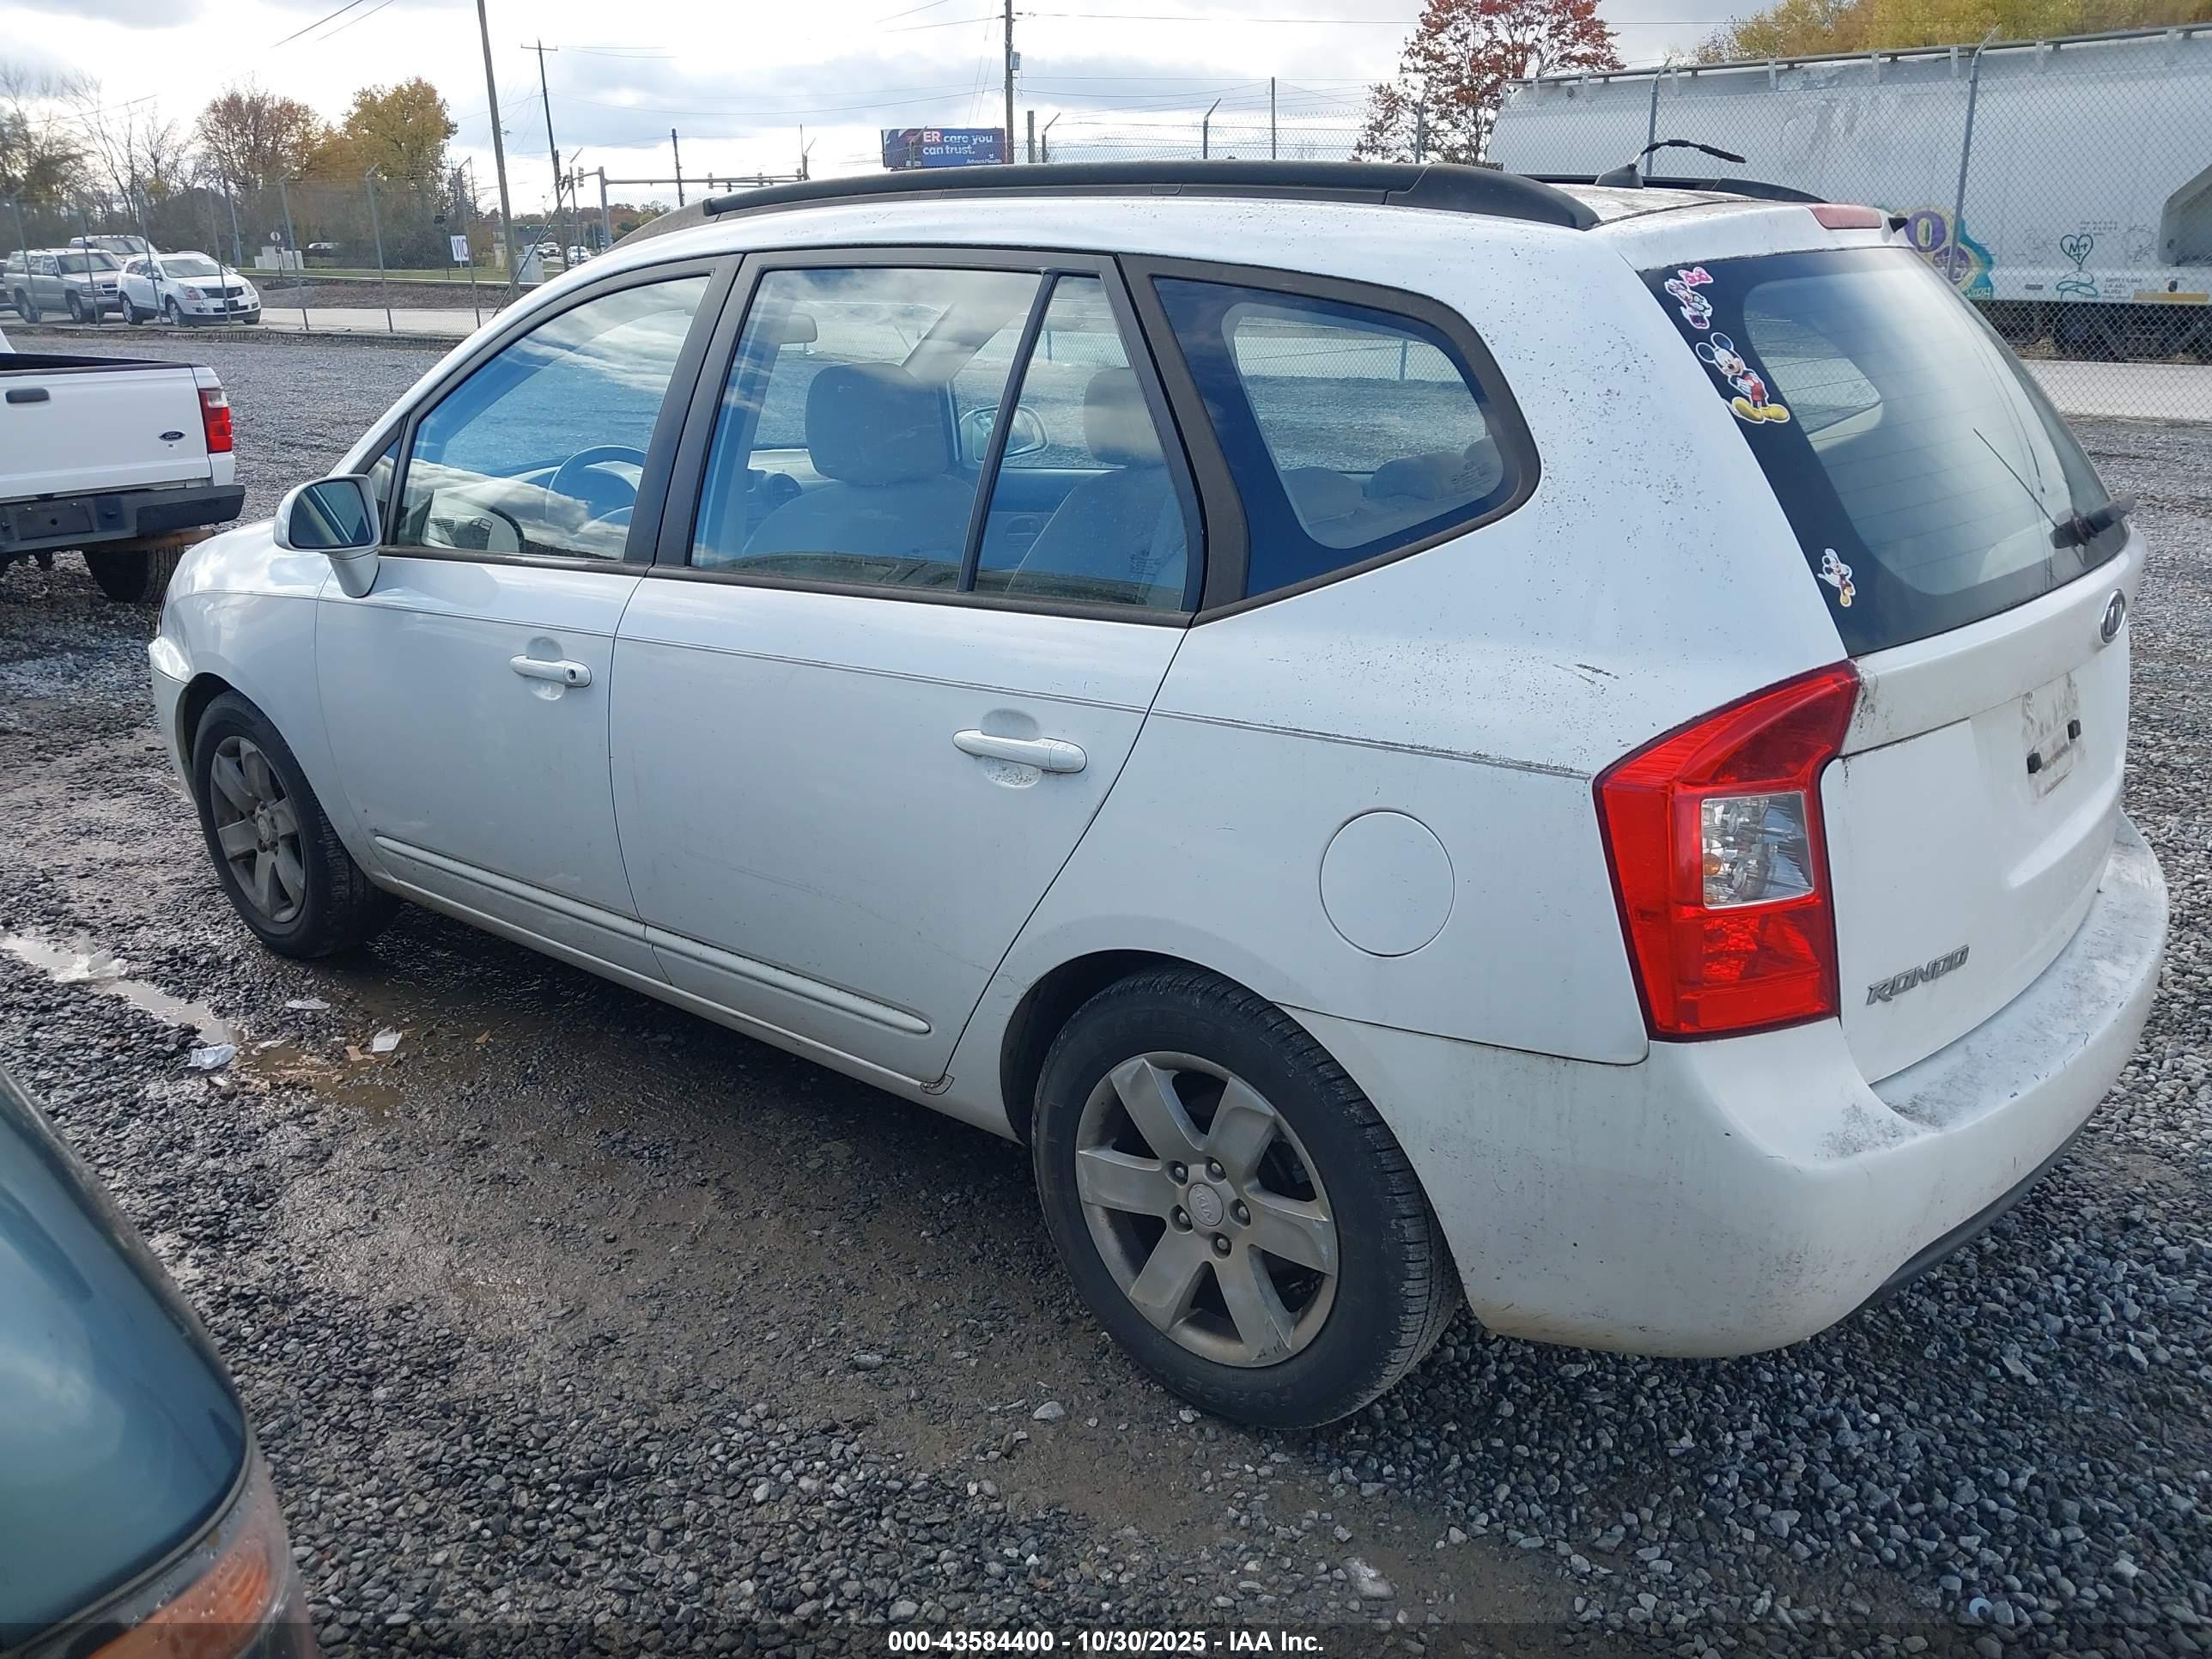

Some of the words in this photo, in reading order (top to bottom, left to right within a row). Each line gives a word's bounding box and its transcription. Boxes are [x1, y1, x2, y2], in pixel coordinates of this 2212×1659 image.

[923, 131, 941, 143] ER
[944, 135, 969, 143] care
[972, 135, 994, 145] you
[922, 146, 944, 155] can
[945, 144, 975, 155] trust.
[1866, 945, 1969, 1005] RONDO
